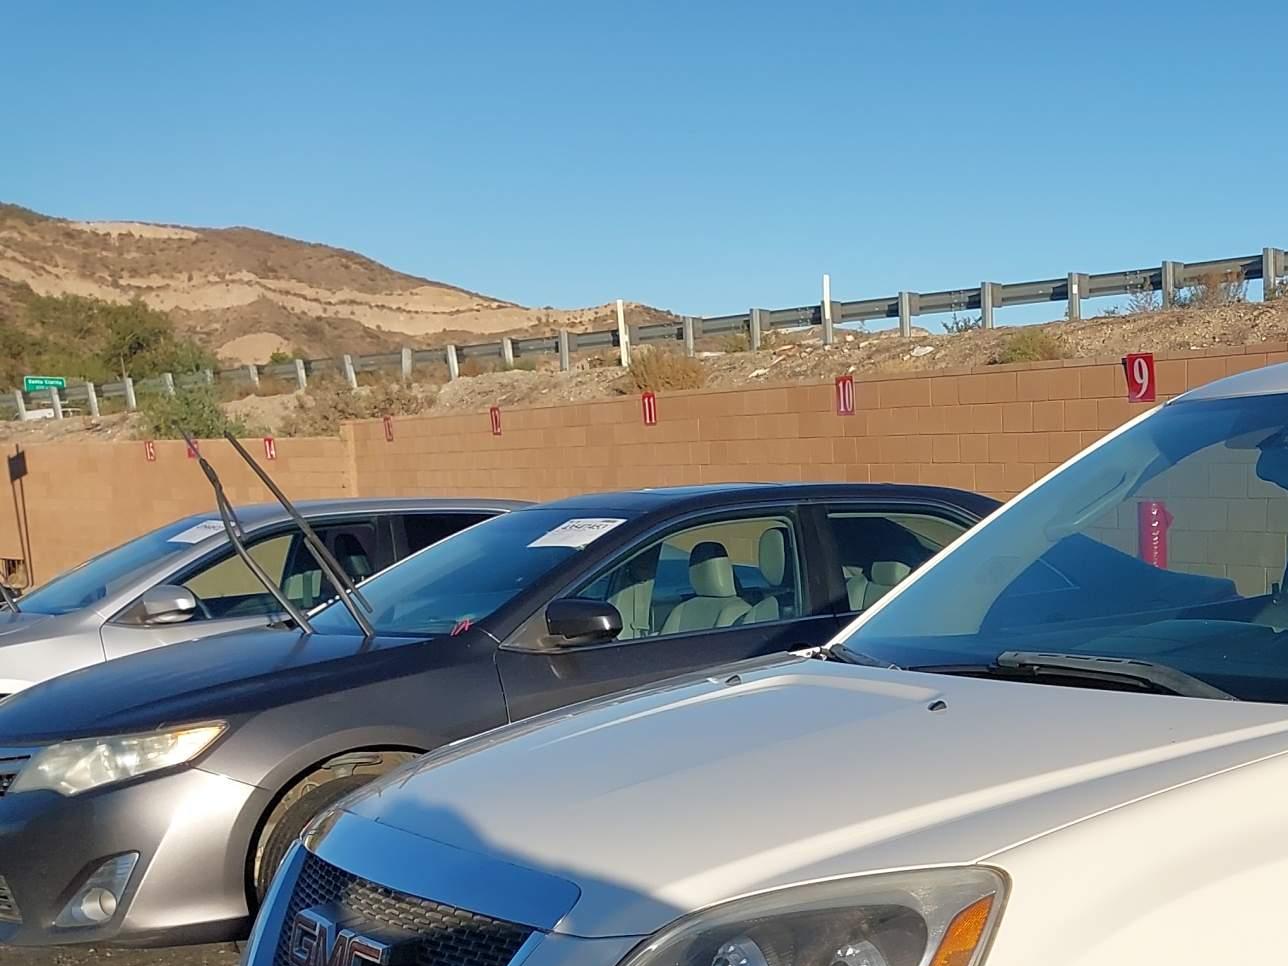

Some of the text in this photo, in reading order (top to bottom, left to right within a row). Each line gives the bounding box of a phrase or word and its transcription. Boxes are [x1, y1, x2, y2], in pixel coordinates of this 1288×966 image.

[1133, 358, 1149, 399] 9
[644, 396, 656, 424] 11
[838, 379, 853, 411] 10
